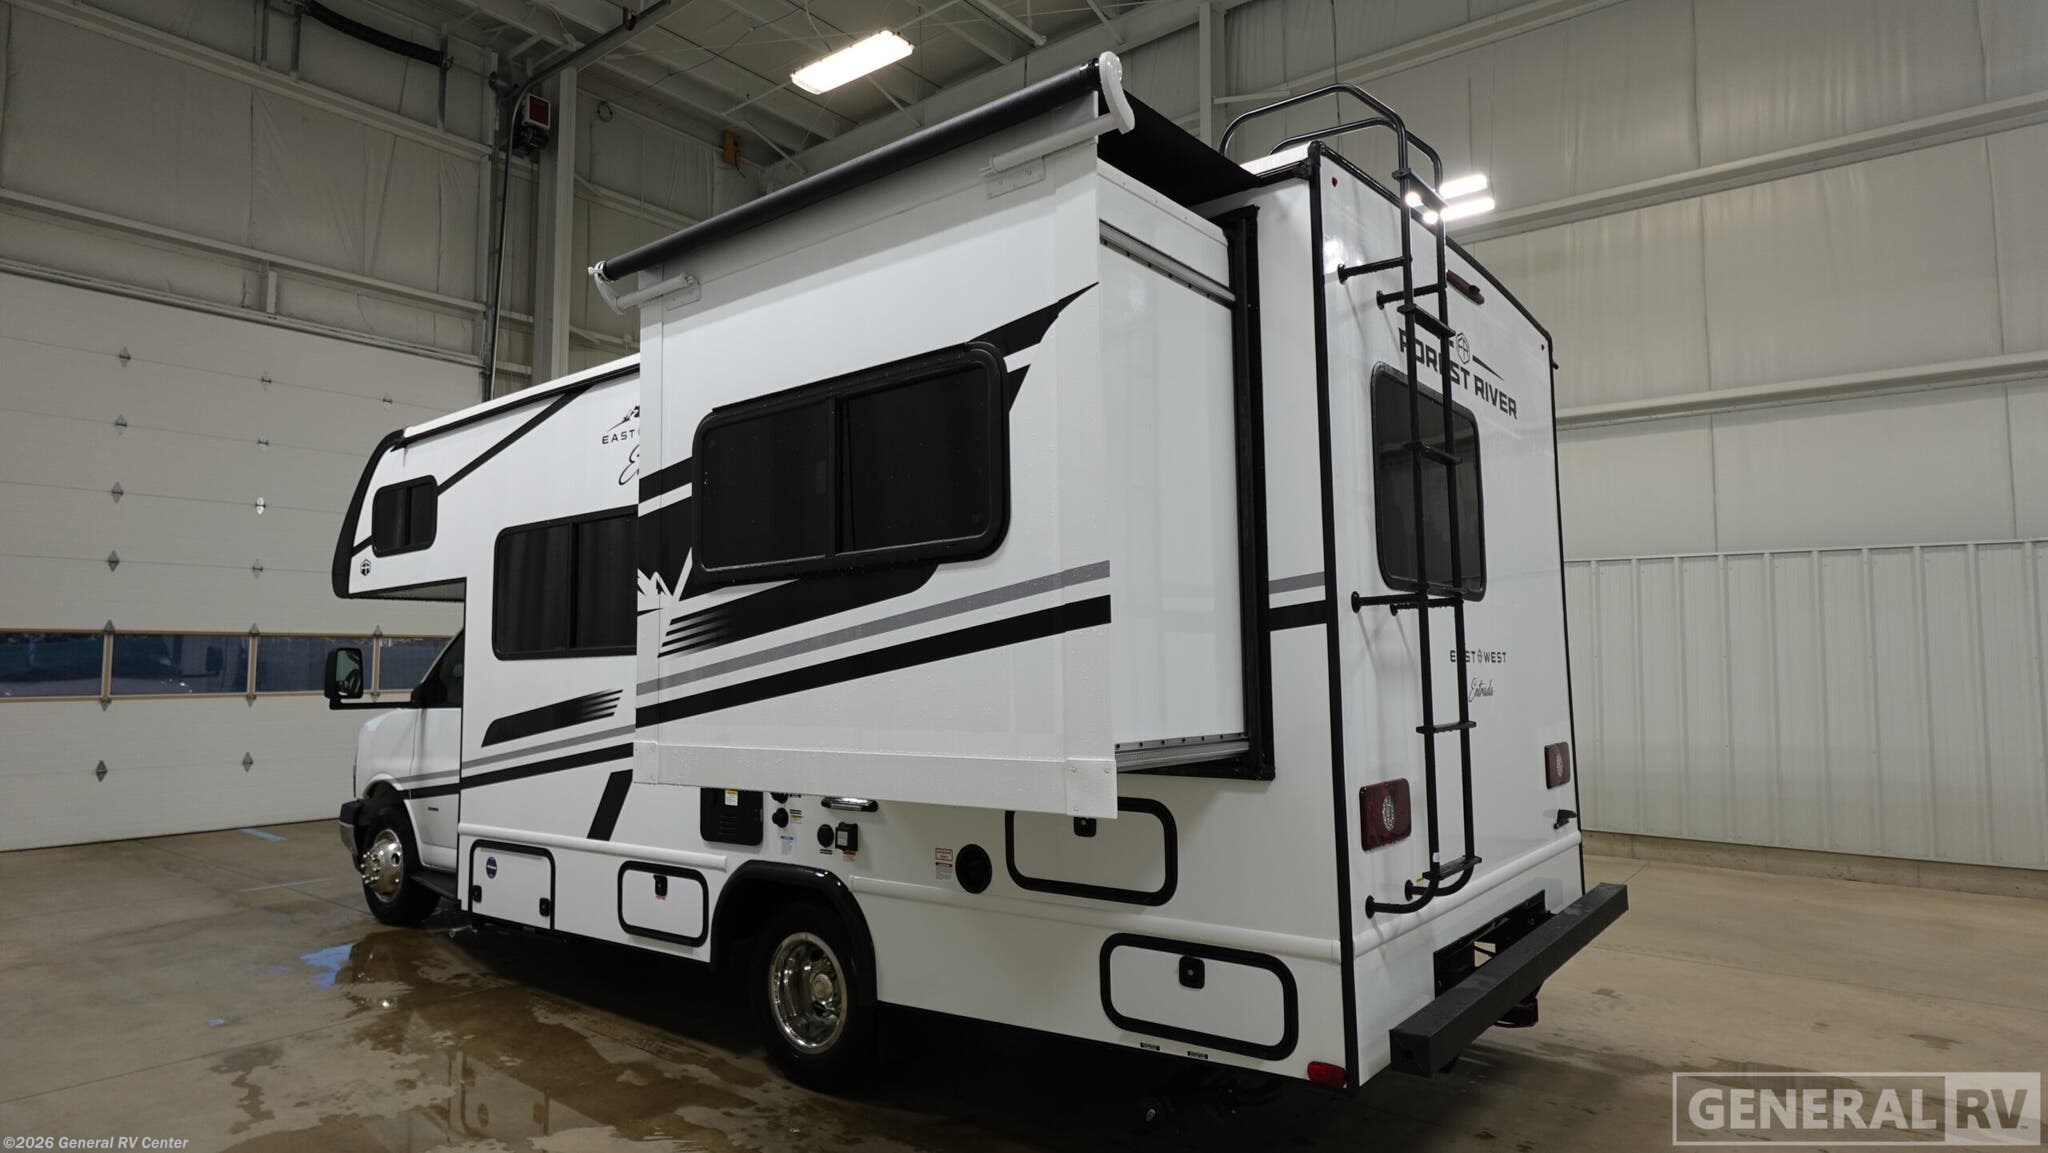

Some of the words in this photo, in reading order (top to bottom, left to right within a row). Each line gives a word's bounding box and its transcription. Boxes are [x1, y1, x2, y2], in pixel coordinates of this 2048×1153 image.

[1398, 327, 1470, 390] FORST
[1473, 374, 1518, 420] RIVER
[601, 429, 636, 445] EAST
[1449, 649, 1476, 663] EST
[1483, 651, 1507, 664] WEST
